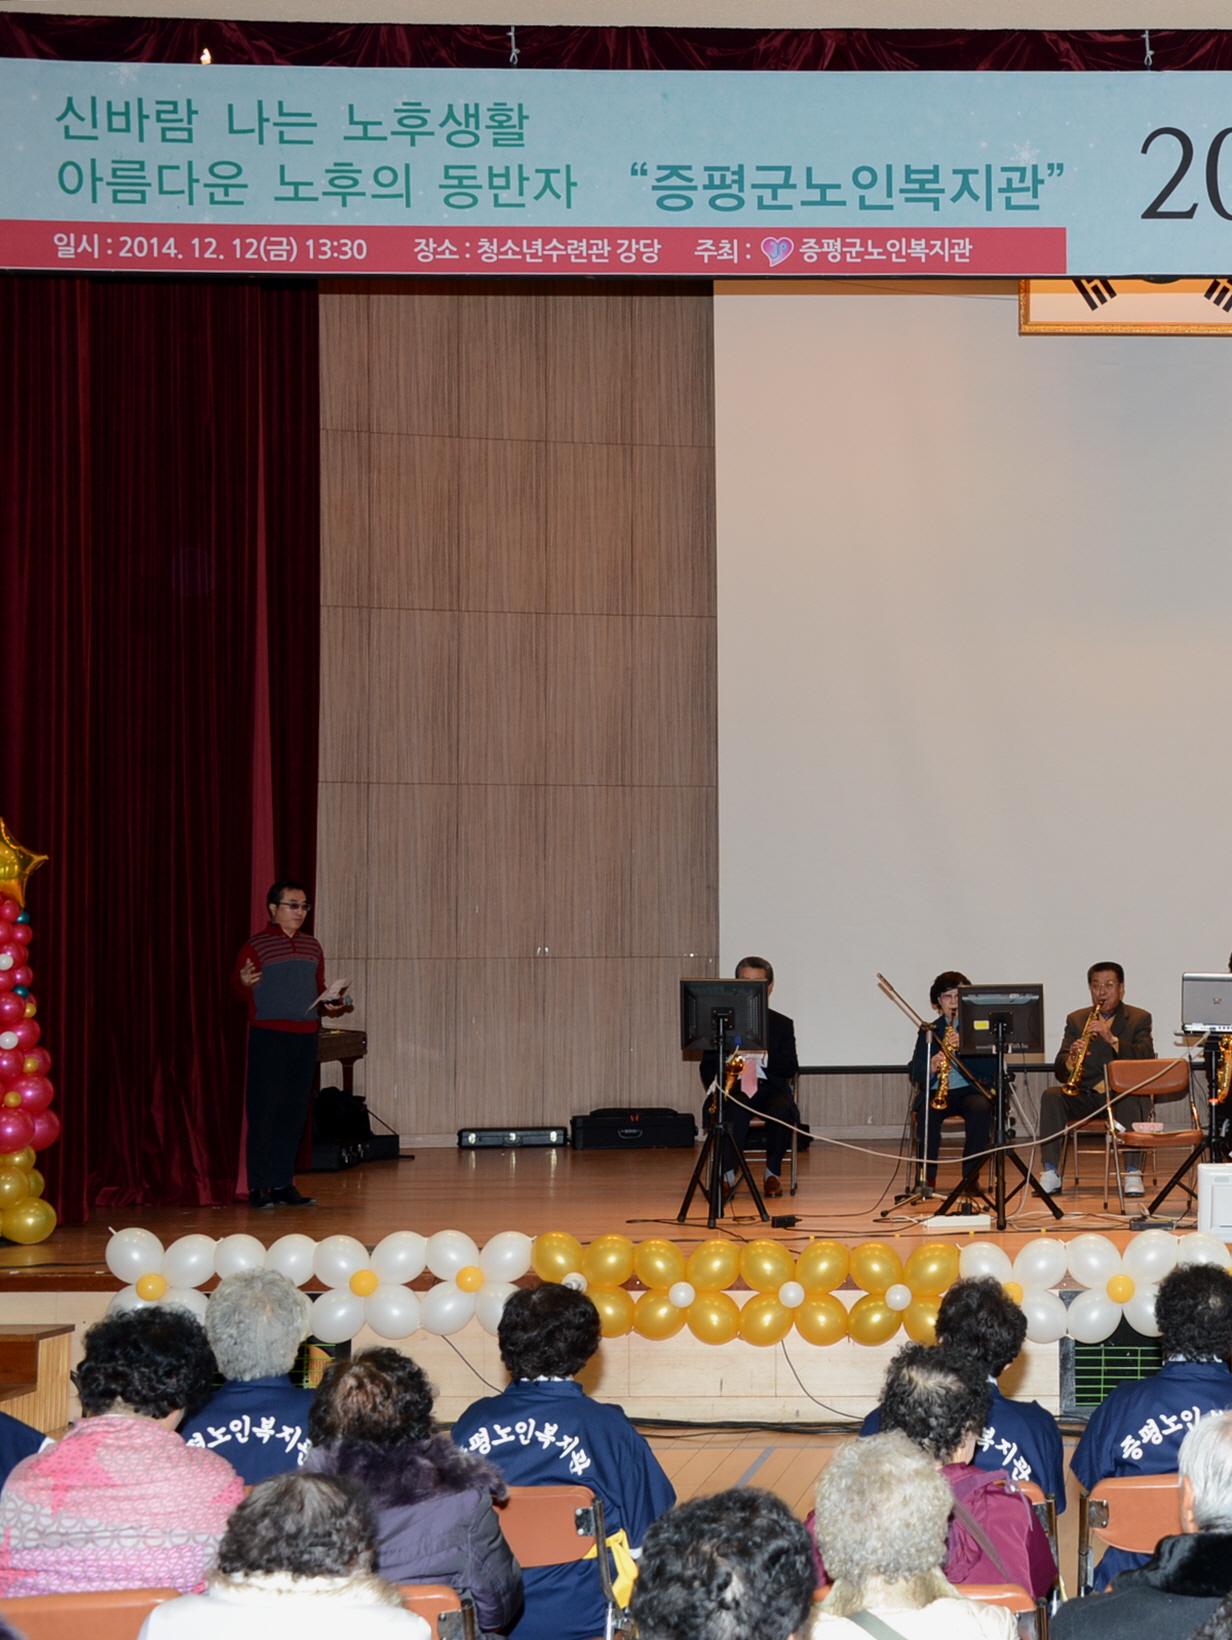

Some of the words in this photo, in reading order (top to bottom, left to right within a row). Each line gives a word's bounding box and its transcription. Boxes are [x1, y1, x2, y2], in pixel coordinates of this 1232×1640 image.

[54, 94, 200, 144] 신바람
[226, 99, 319, 146] 나는
[342, 101, 531, 149] 노후생활
[56, 157, 250, 207] 아름다운
[272, 161, 413, 210] 노후의
[437, 162, 579, 211] 동반자
[118, 236, 184, 260] 2014.
[192, 237, 225, 260] 12.
[232, 235, 299, 262] 12(금)
[305, 239, 368, 260] 13:30
[477, 238, 612, 264] 청소년수련관
[615, 238, 662, 264] 강당
[798, 237, 974, 264] 증평군노인복지관
[459, 1417, 592, 1476] 평노인복지관
